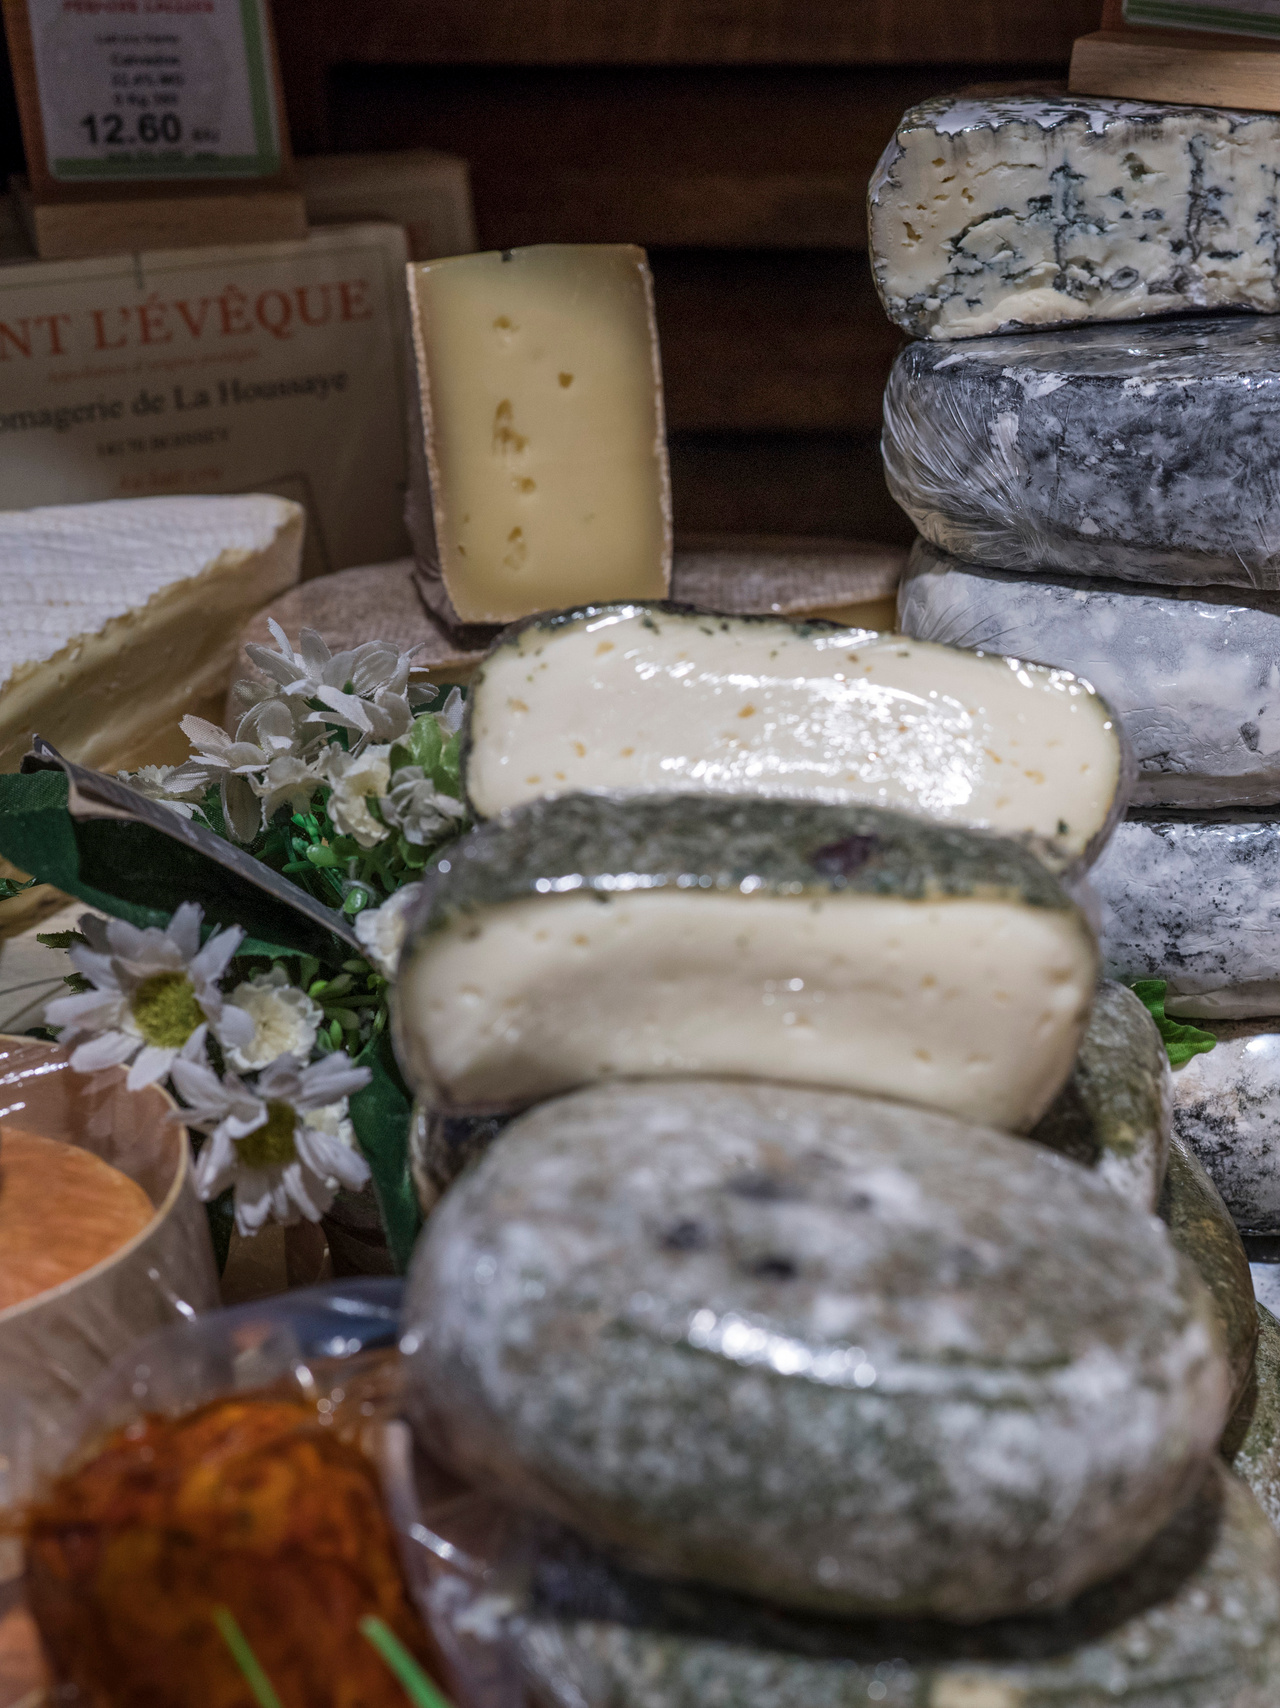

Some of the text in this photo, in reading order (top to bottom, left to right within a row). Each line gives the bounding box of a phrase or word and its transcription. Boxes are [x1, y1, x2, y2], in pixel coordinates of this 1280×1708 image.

[80, 113, 182, 144] 12.60
[131, 389, 165, 416] de
[174, 384, 213, 411] La
